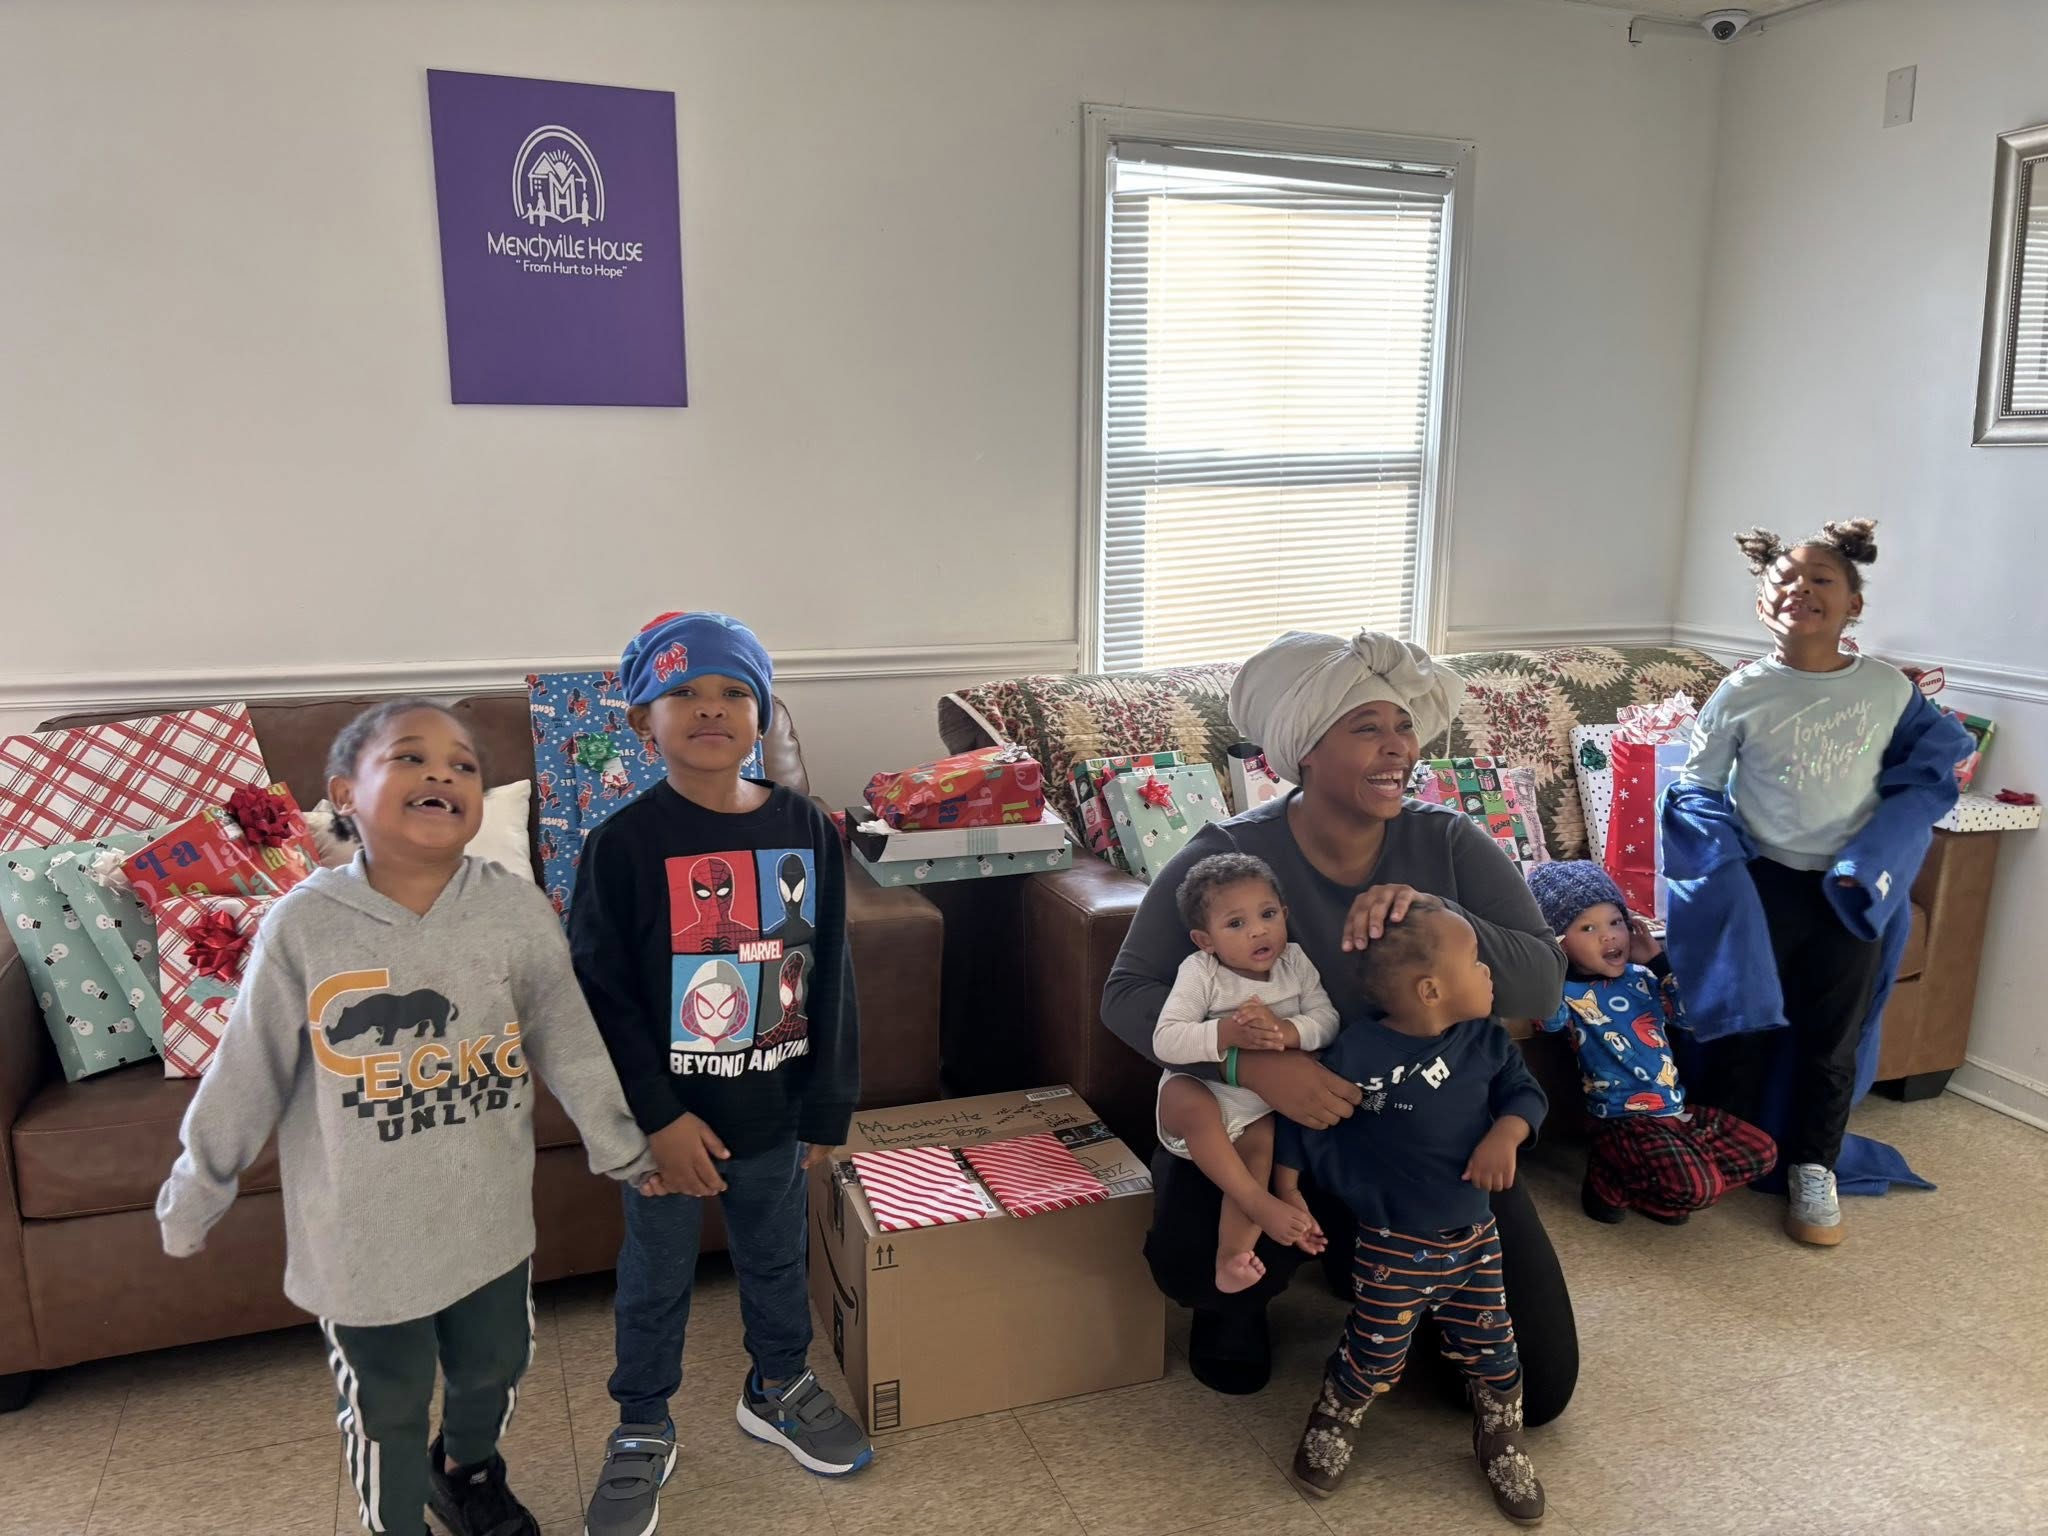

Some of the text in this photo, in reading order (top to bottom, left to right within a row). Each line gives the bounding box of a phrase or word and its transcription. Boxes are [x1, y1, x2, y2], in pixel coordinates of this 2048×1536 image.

[553, 262, 579, 275] Hurt
[581, 264, 593, 276] to
[1768, 697, 1873, 746] Tommy
[135, 840, 202, 881] Fa
[739, 942, 783, 963] MARVEL
[670, 1052, 746, 1078] BEYOND
